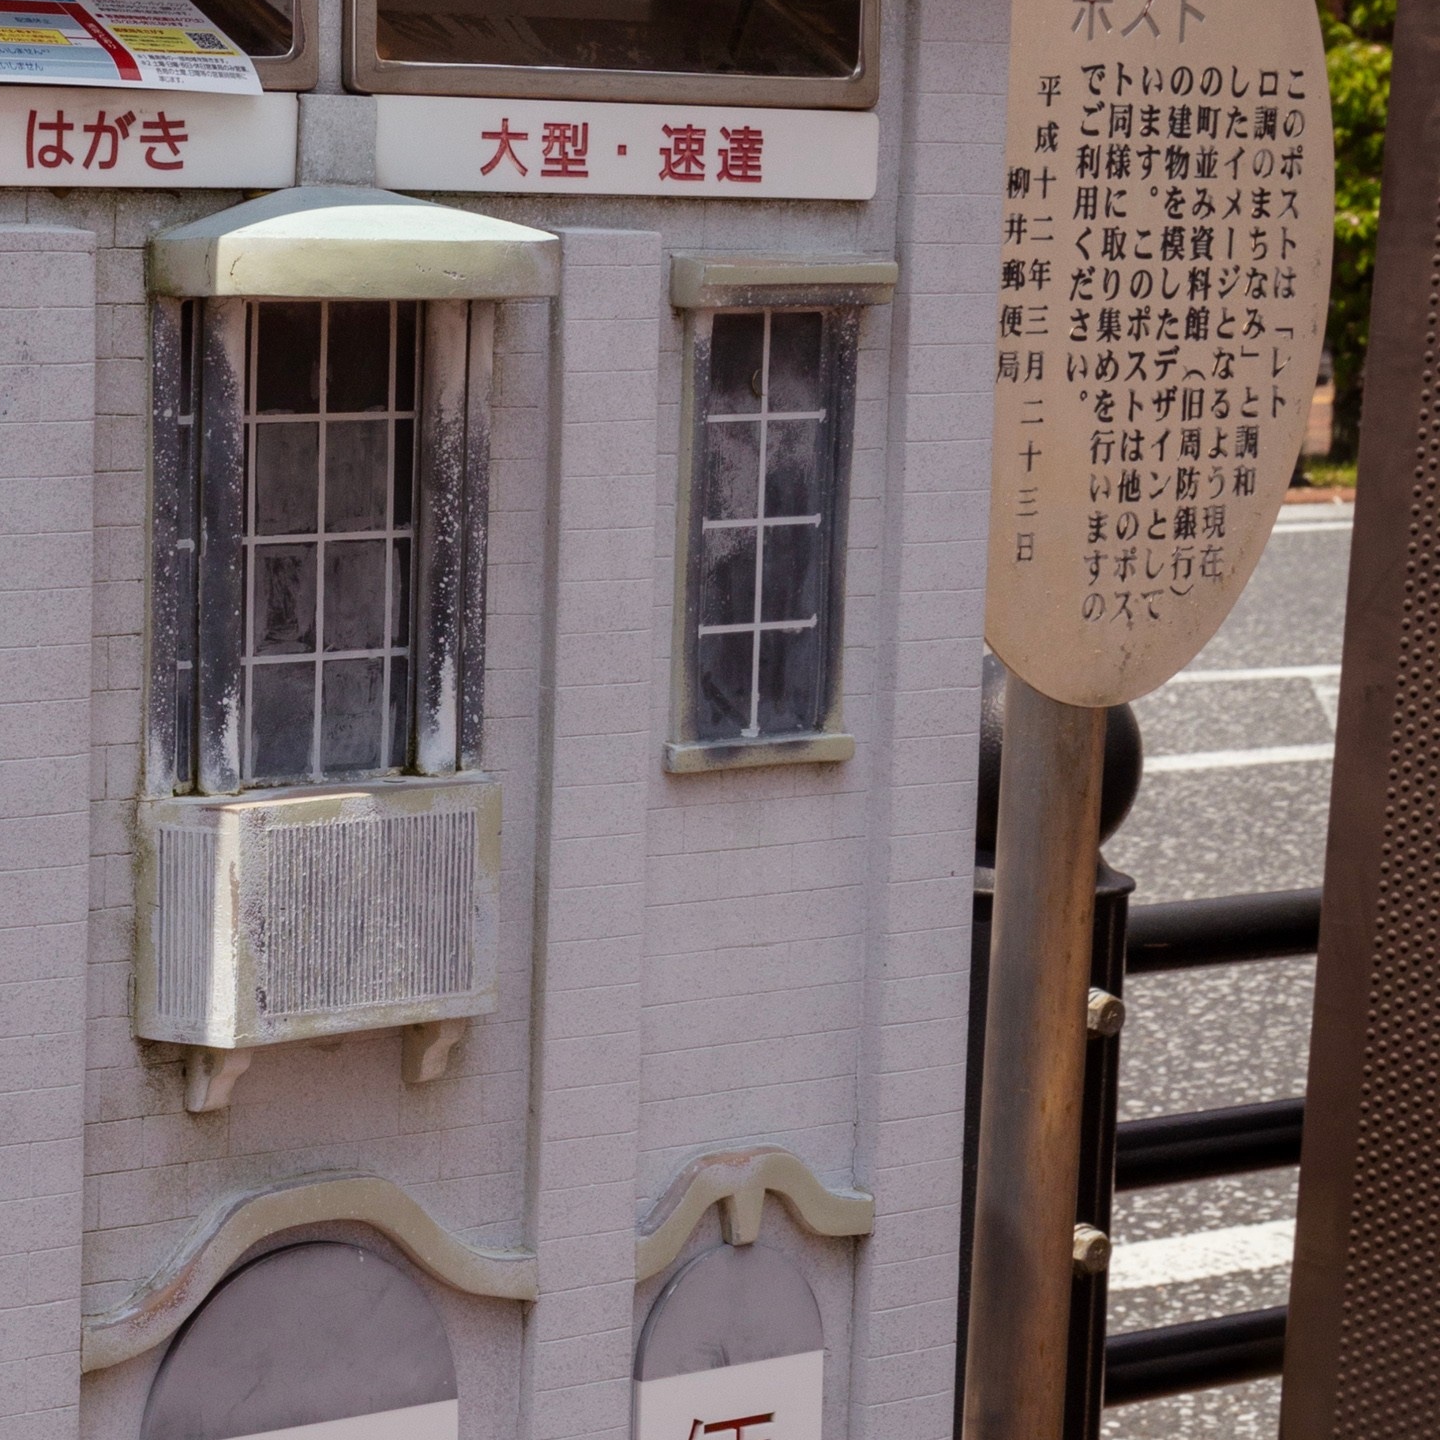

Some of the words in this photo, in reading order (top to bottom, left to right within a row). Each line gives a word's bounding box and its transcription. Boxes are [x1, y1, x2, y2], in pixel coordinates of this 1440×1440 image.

[480, 117, 765, 183] 大型・速達
[996, 167, 1030, 385] 柳井郵便局
[1016, 75, 1062, 563] 平成十二年三月二十三日
